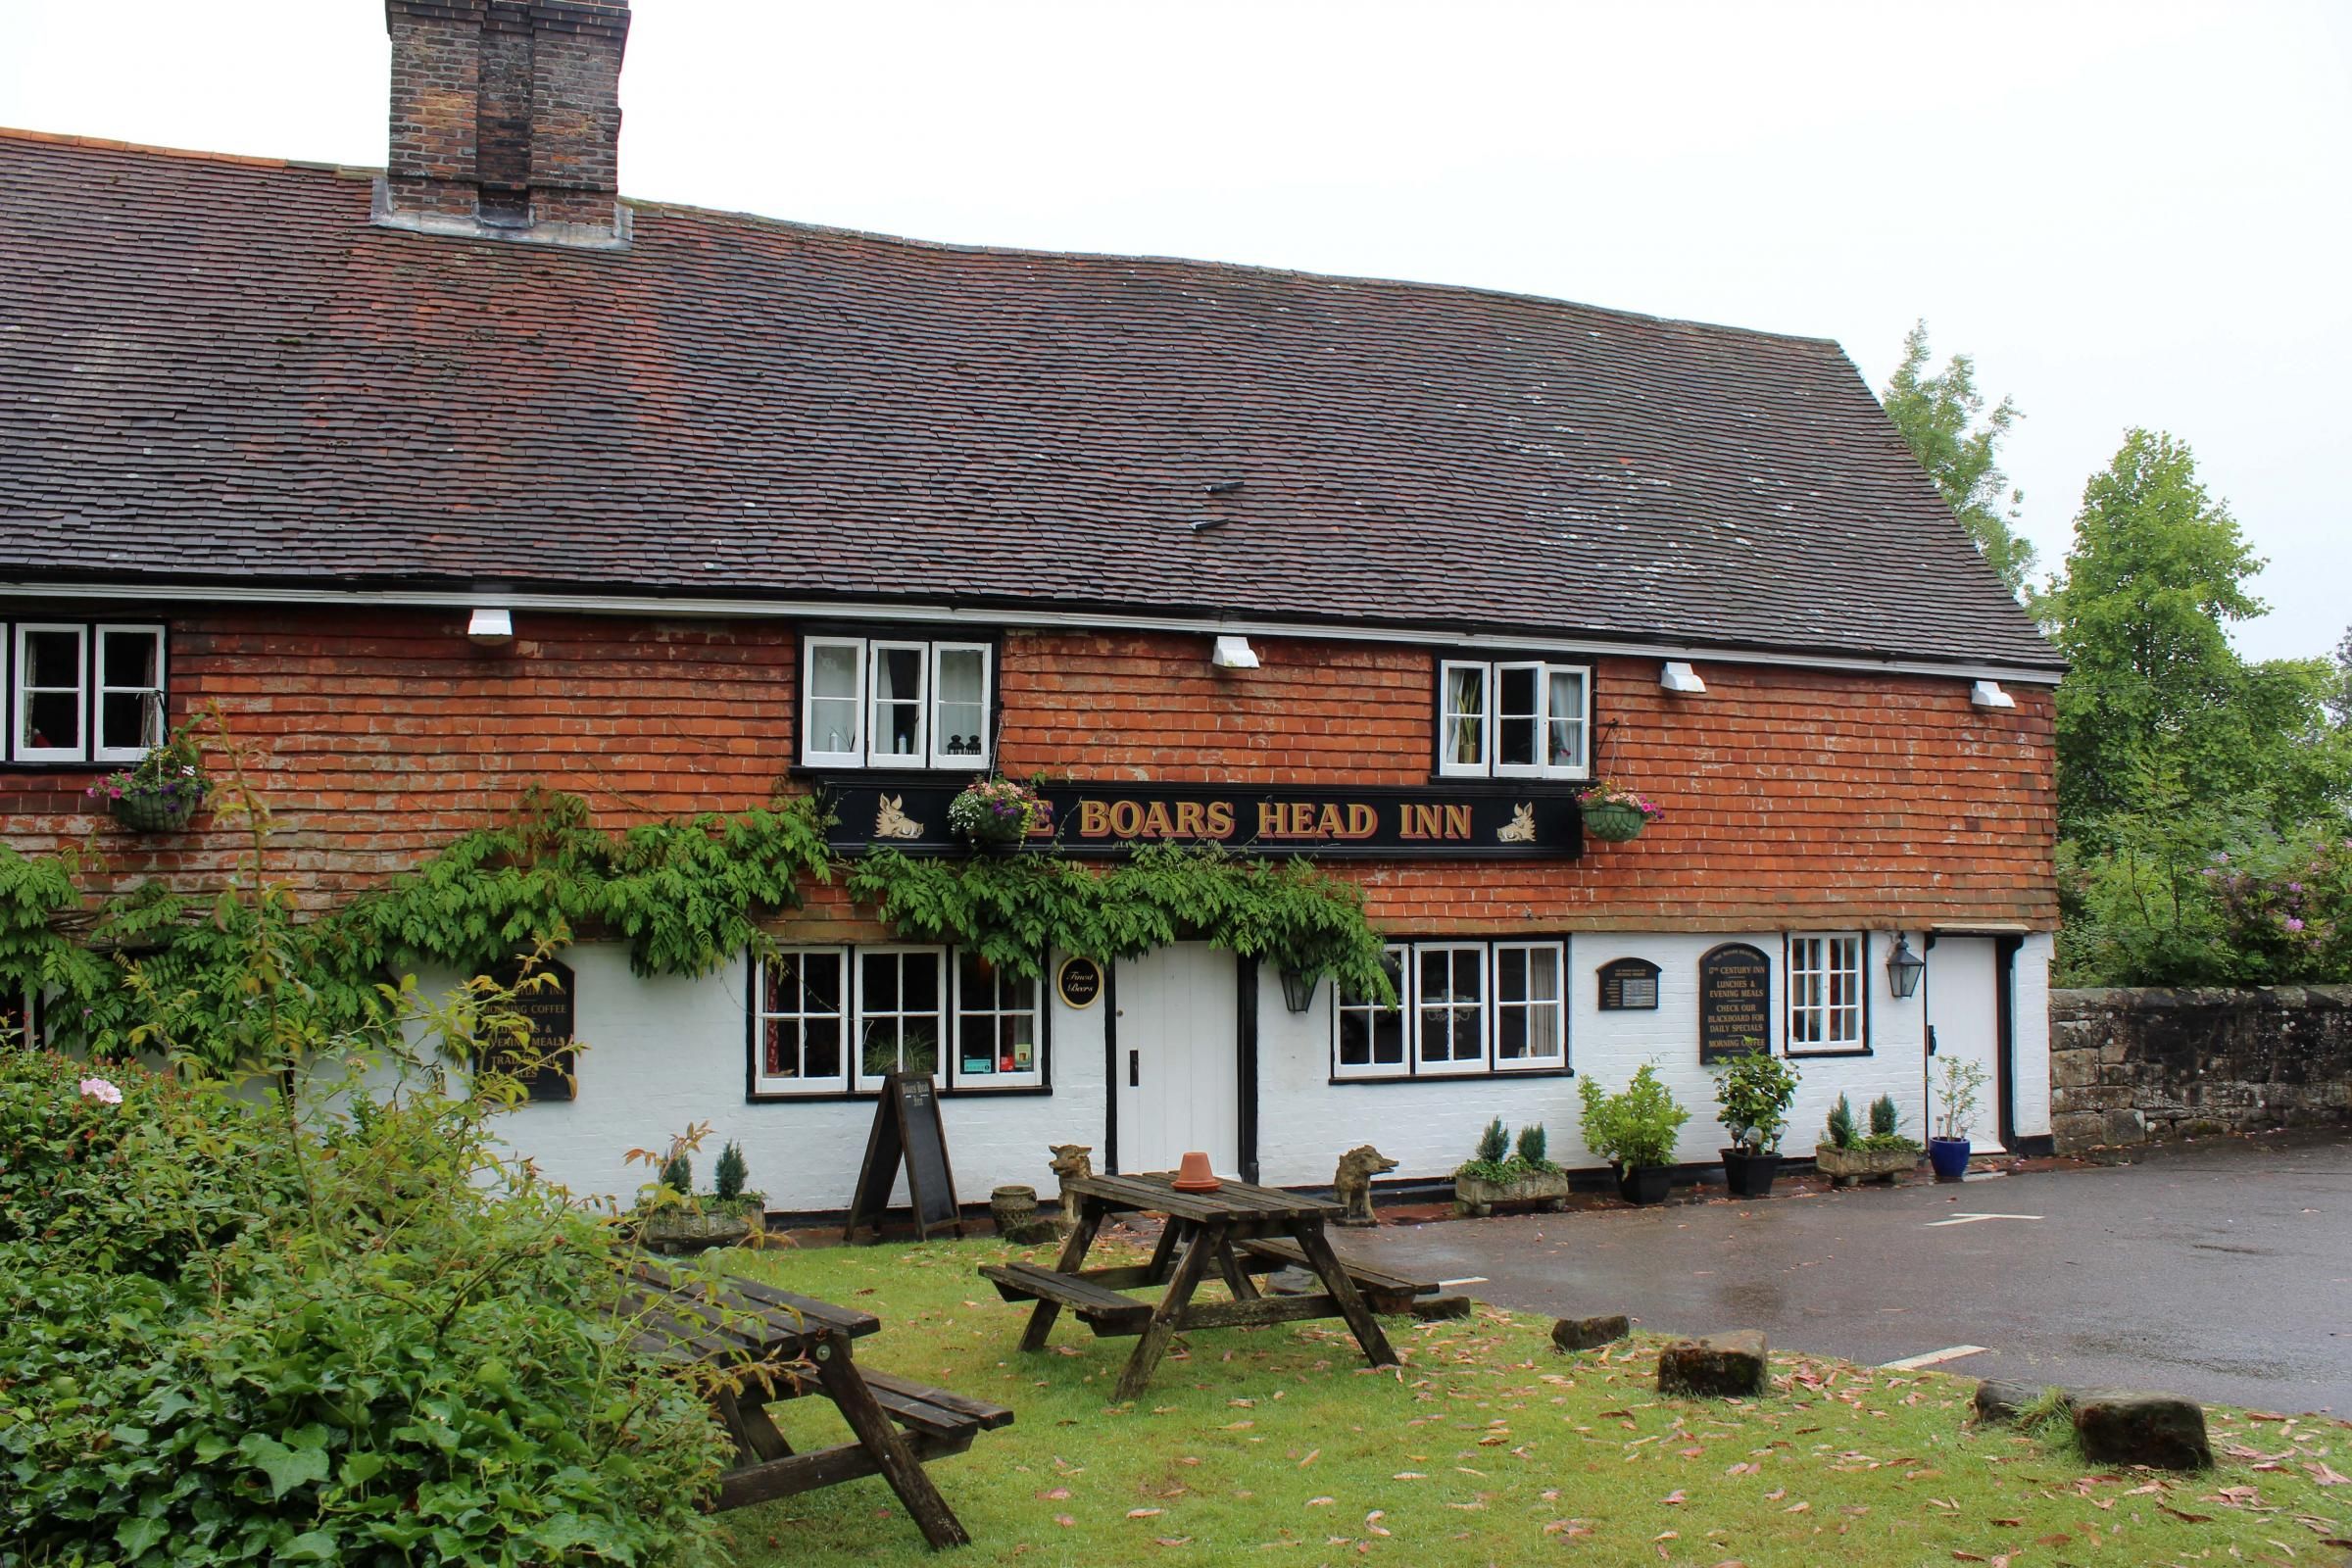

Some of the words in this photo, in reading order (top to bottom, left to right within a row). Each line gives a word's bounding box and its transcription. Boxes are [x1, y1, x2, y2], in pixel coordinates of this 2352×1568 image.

[1080, 800, 1236, 838] BOARS
[1256, 802, 1378, 839] HEAD
[1399, 804, 1472, 839] INN
[1720, 966, 1751, 975] CENTURY
[530, 1004, 566, 1013] COFFEE
[1708, 1014, 1750, 1023] BLACKBOARD
[1751, 1013, 1765, 1022] FOR
[1708, 1040, 1740, 1049] MORNING
